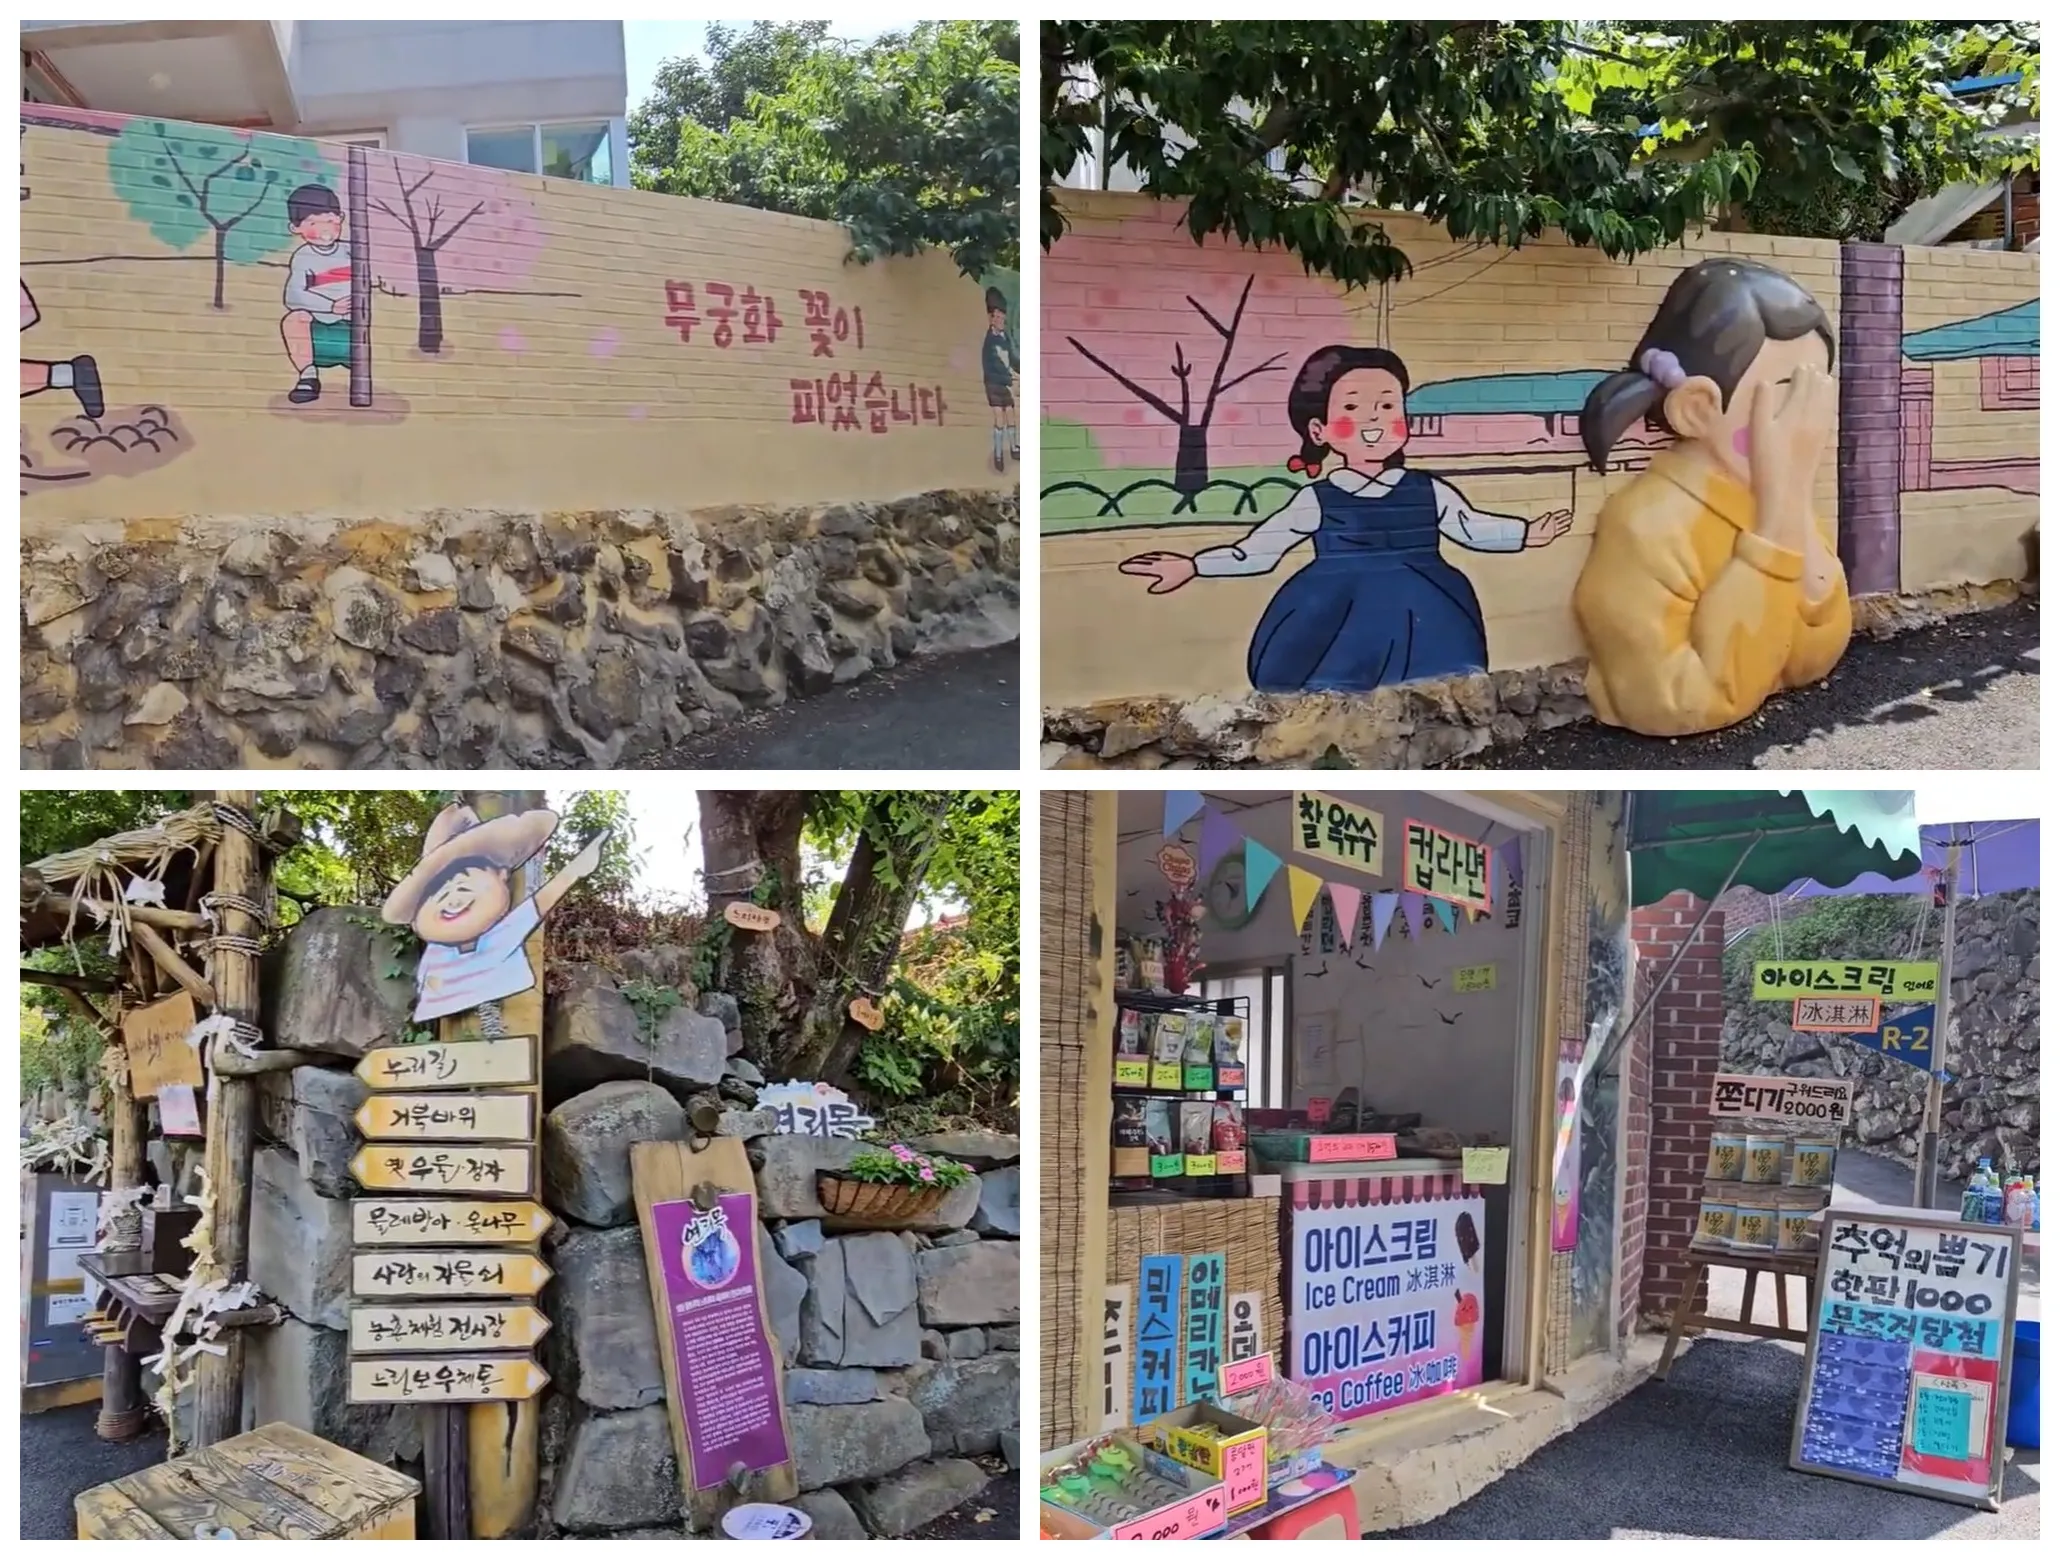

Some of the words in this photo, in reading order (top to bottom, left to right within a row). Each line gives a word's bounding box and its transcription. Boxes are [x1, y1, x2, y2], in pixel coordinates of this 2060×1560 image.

[664, 279, 783, 349] 무궁화
[799, 288, 864, 358] 꽃이
[790, 369, 947, 434] 피었습니다
[1409, 824, 1487, 899] 컵라면
[1761, 966, 1896, 995] 아이스크림
[1801, 1003, 1870, 1024] 冰淇淋
[1881, 1026, 1930, 1051] R-2
[382, 1049, 457, 1082] 누리길
[1715, 1082, 1786, 1112] 쫀디기
[1783, 1101, 1844, 1121] 2000원
[390, 1104, 476, 1134] 거북바위
[367, 1207, 451, 1236] 물레방아
[1305, 1218, 1438, 1273] 아이스크림
[1305, 1281, 1336, 1311] Ice
[1343, 1273, 1401, 1304] Cream
[1406, 1262, 1457, 1292] 冰淇淋
[449, 1313, 507, 1341] 전시장
[1140, 1264, 1174, 1416] 믹스커피
[1303, 1310, 1436, 1377] 아이스커피
[1310, 1390, 1334, 1414] ce
[1341, 1371, 1404, 1409] Coffee
